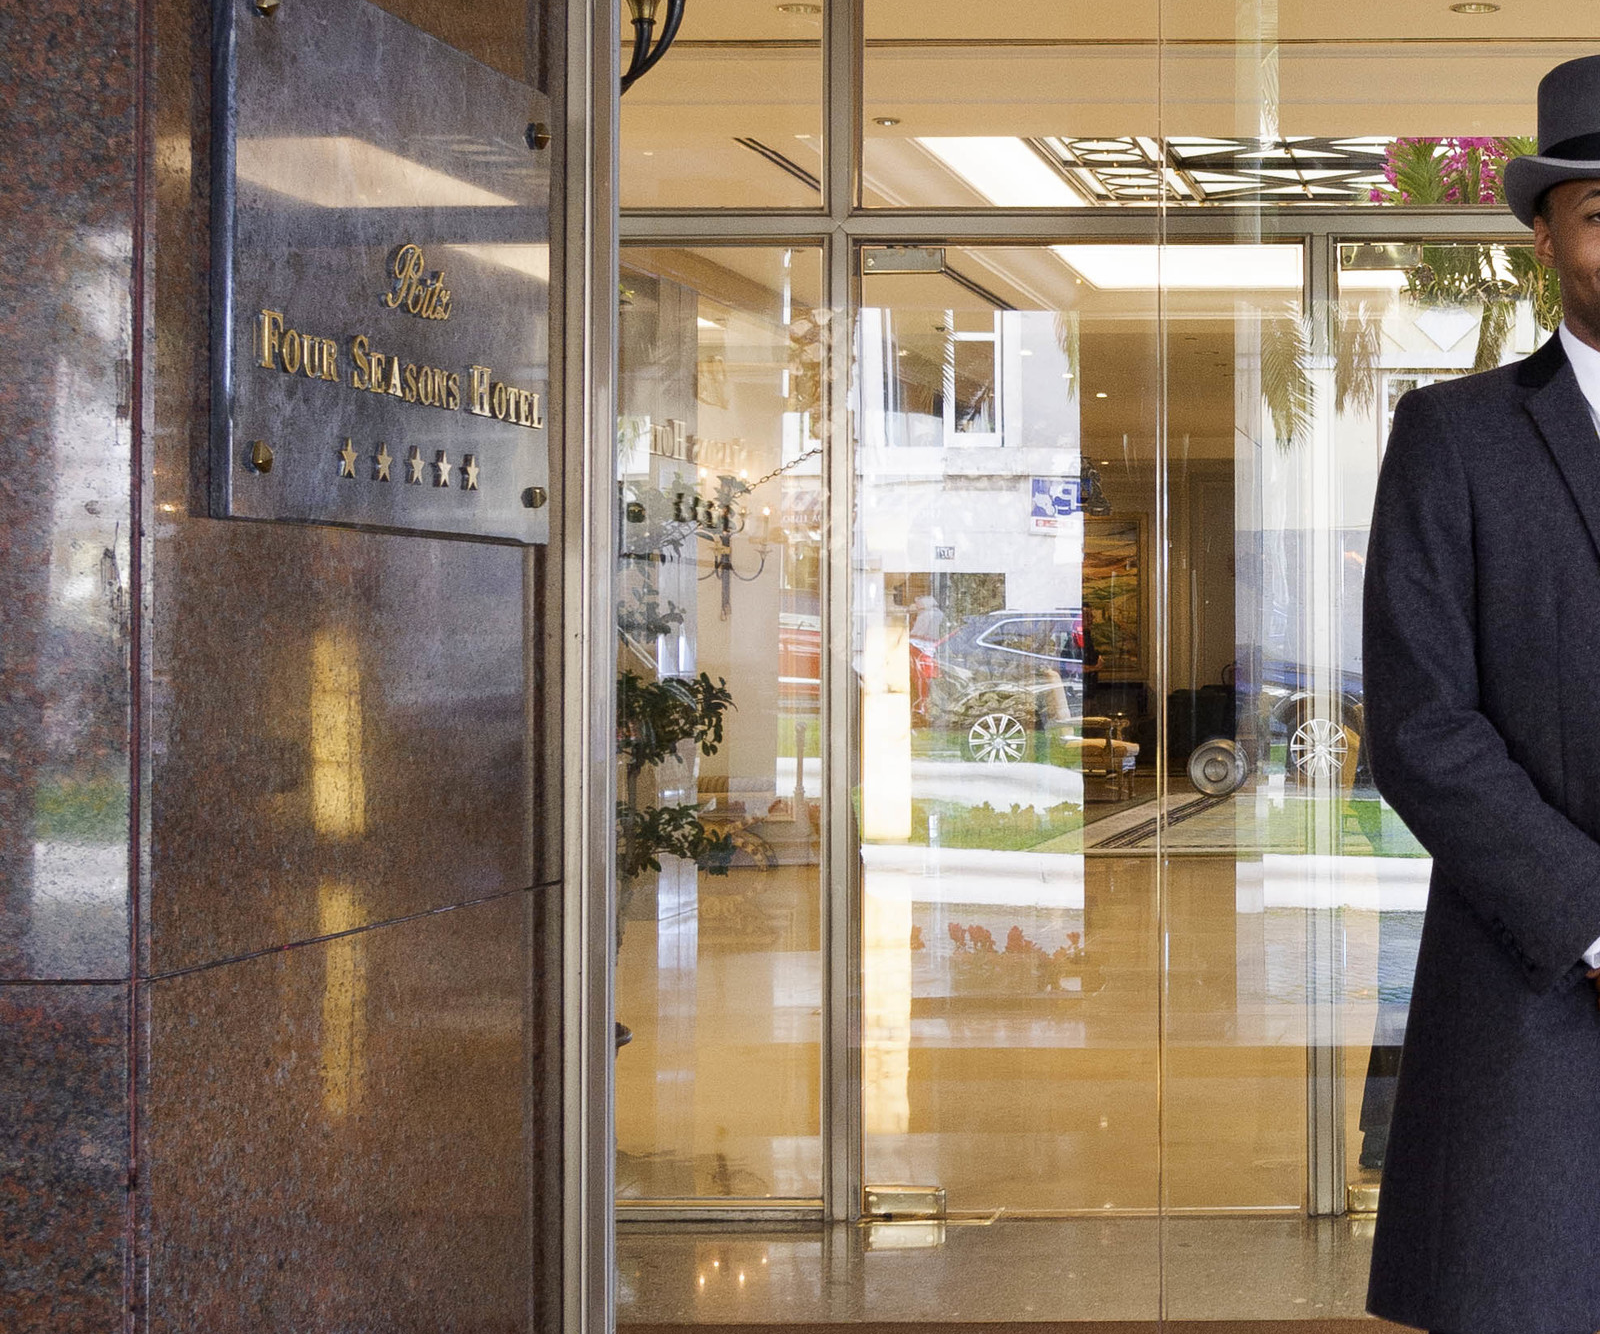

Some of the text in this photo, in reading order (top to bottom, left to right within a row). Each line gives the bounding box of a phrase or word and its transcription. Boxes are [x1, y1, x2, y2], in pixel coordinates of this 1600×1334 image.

[386, 243, 452, 320] Ritz
[260, 309, 544, 430] FOUR SEASONS HOTEL
